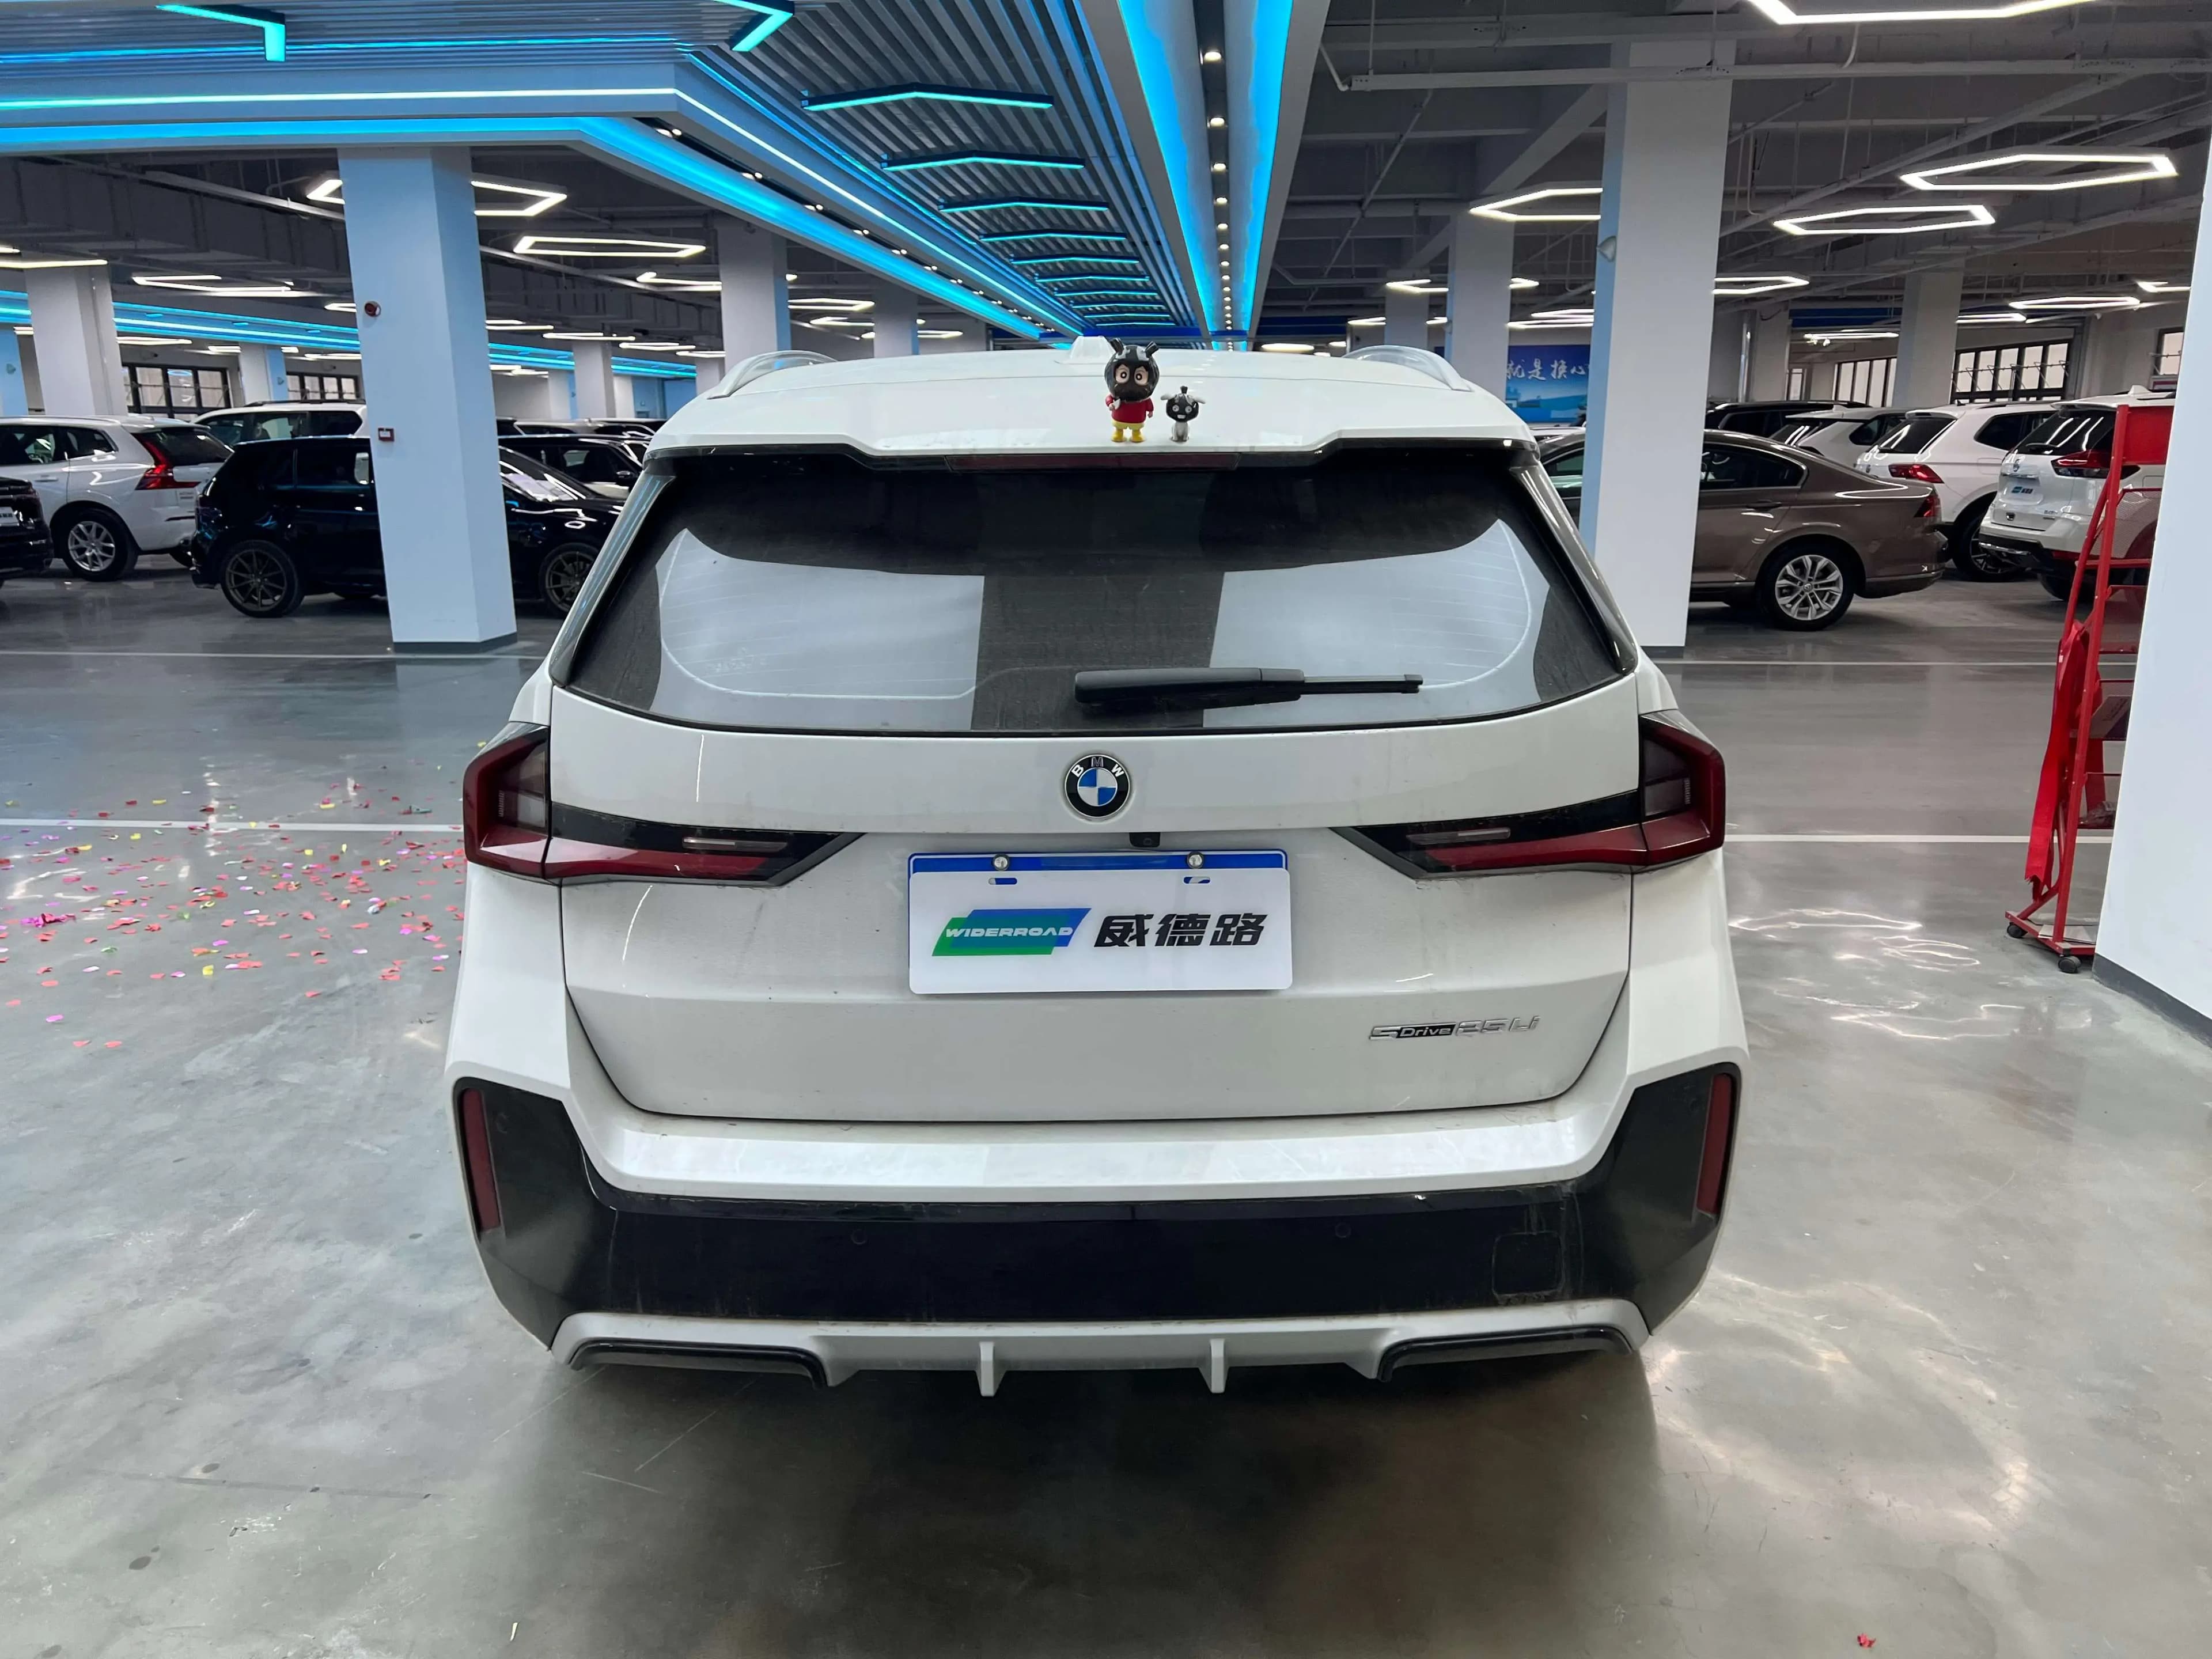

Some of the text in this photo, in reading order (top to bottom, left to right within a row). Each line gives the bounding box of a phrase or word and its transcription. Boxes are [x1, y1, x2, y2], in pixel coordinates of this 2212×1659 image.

[1071, 757, 1124, 777] BMW
[946, 927, 1073, 938] WIDERROAD
[1094, 912, 1268, 948] 威德路
